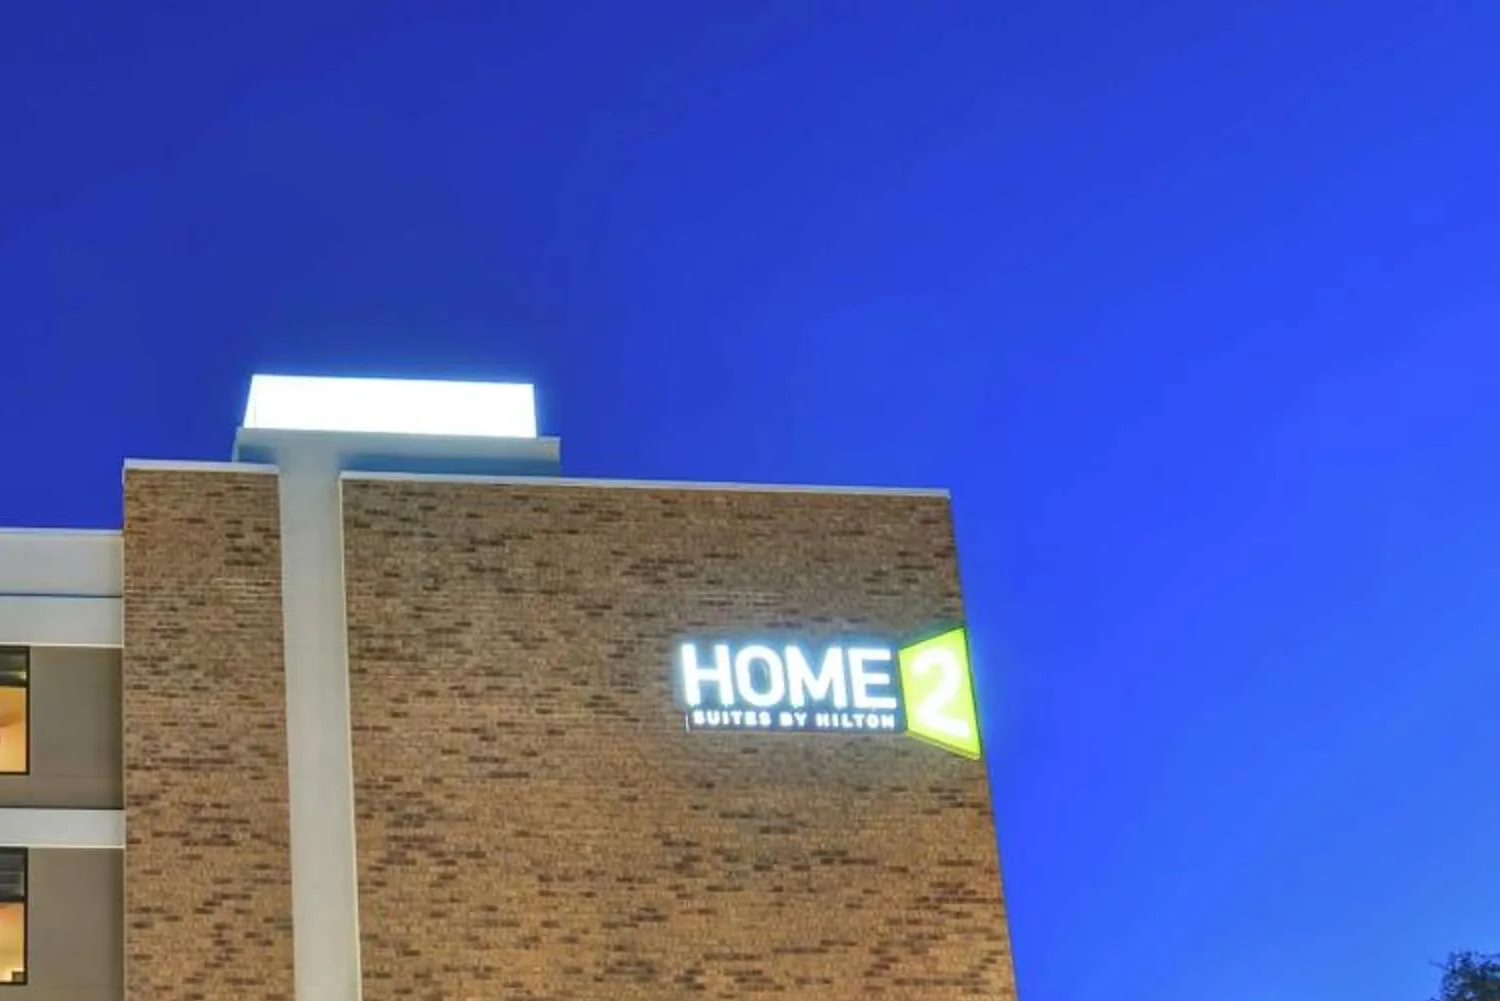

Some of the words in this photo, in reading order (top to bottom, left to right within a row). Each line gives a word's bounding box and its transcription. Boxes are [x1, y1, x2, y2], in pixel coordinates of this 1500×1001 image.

[680, 643, 897, 710] HOME
[693, 709, 772, 727] SUITES
[779, 711, 807, 728] BY
[815, 712, 896, 729] HILTON
